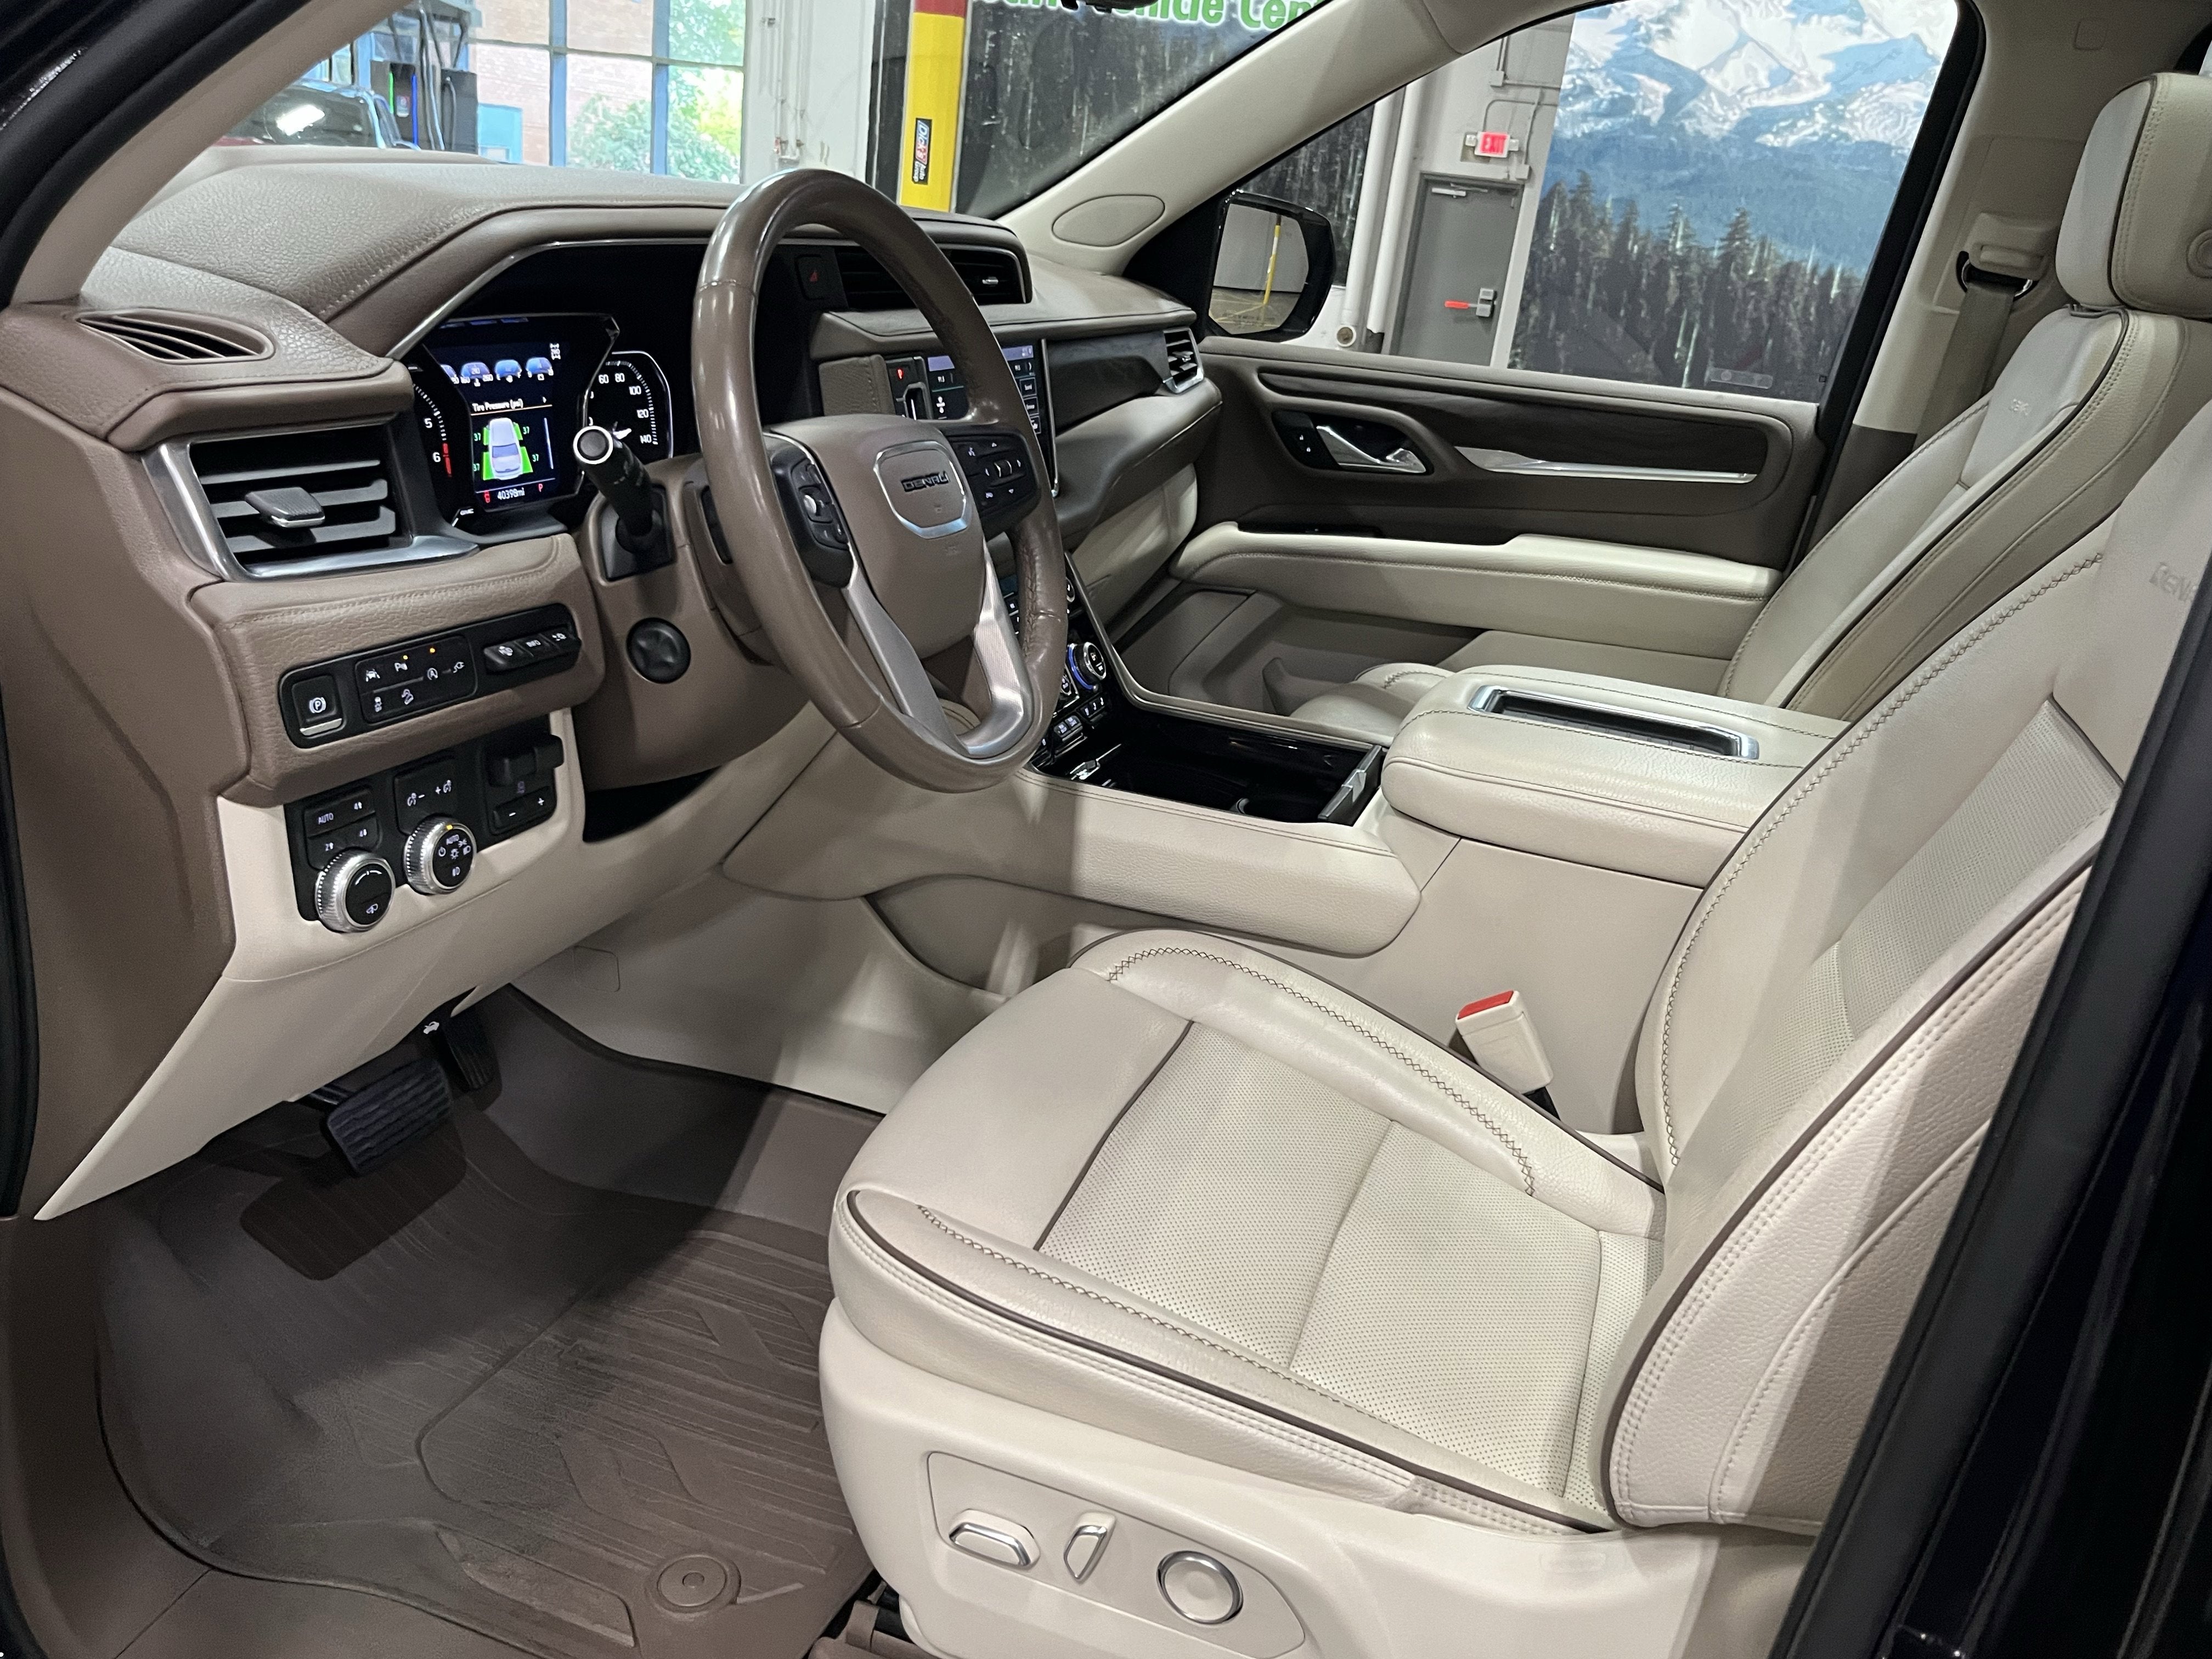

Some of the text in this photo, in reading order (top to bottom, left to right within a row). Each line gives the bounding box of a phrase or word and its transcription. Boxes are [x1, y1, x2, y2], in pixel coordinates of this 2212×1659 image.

[1240, 0, 1324, 30] Cen
[1482, 133, 1508, 155] EXIT
[598, 374, 609, 384] 60
[614, 373, 625, 382] 80
[628, 385, 642, 395] 100
[424, 417, 433, 429] 5
[523, 426, 530, 435] 37
[473, 432, 481, 442] 37
[640, 434, 652, 444] 140
[432, 452, 441, 462] 6
[532, 454, 539, 462] 37
[473, 463, 480, 472] 37
[901, 471, 950, 492] DENALI
[318, 812, 334, 825] AUTO
